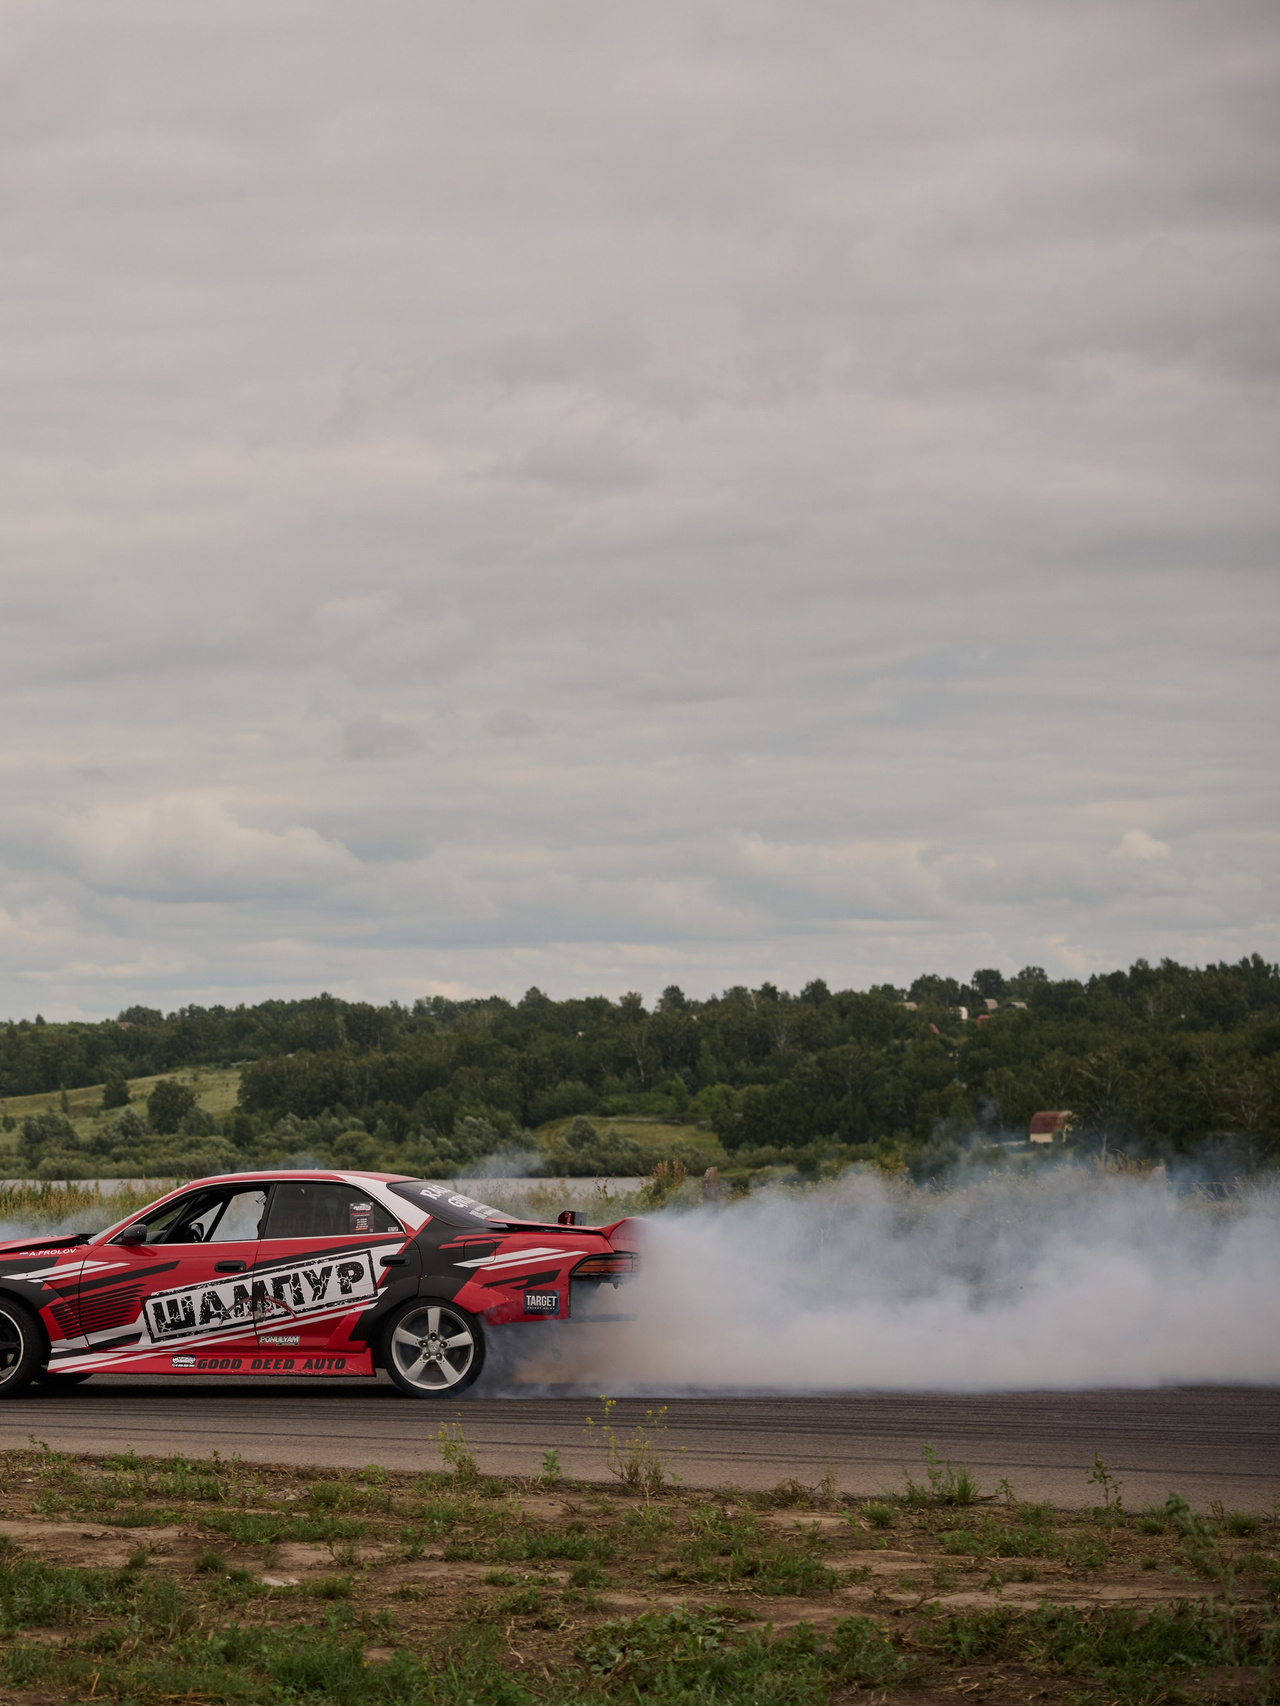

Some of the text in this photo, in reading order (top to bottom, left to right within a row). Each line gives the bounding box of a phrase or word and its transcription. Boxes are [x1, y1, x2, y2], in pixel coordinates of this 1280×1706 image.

[28, 1248, 77, 1257] A.FROLOV
[152, 1261, 365, 1334] ШАМПУР
[526, 1295, 557, 1307] TARGET
[259, 1335, 300, 1343] PONULYAM
[197, 1358, 242, 1370] GOOD
[250, 1358, 295, 1370] DEED
[302, 1358, 347, 1370] AUTO
